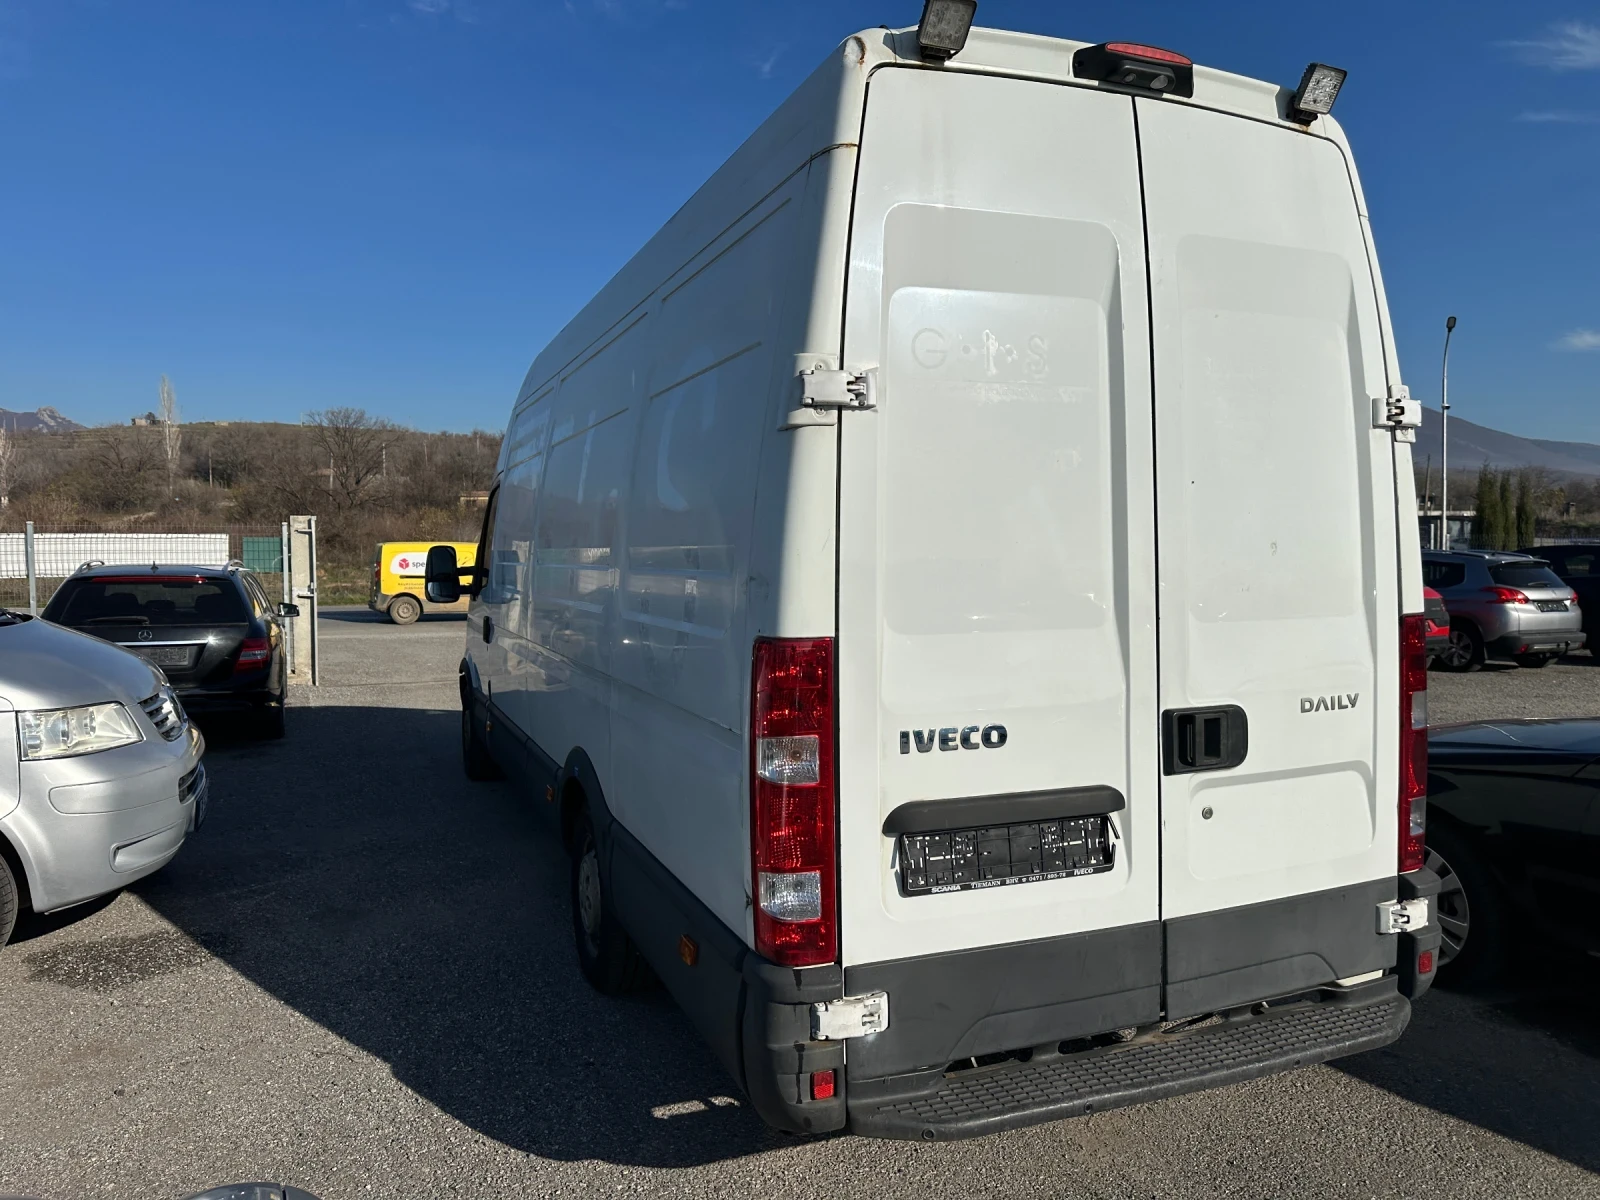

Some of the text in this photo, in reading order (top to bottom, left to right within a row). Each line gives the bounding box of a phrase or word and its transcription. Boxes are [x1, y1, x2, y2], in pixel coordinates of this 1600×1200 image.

[1300, 692, 1360, 714] DAILY
[899, 723, 1008, 755] IVECO
[931, 884, 961, 894] SCANIA
[970, 880, 1001, 889] TIEMANN
[1073, 868, 1094, 876] IVECO
